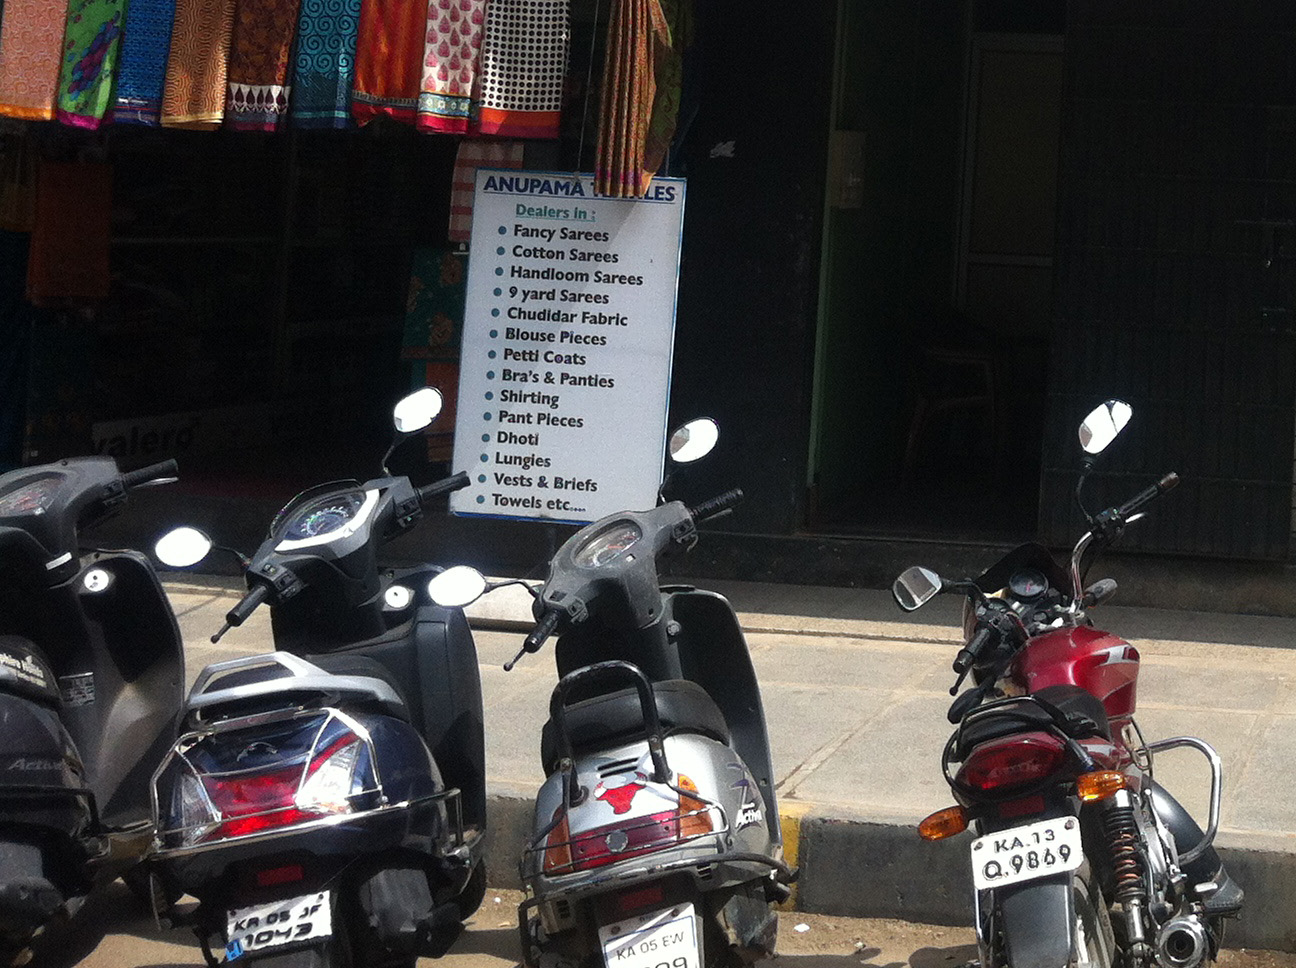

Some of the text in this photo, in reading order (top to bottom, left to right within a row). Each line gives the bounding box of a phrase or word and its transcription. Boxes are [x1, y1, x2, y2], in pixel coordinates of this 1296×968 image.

[483, 176, 586, 196] ANUPAMA
[515, 204, 587, 219] Dealers in
[513, 225, 609, 243] Fancy Sarees
[512, 245, 619, 263] Cotton Sarees
[510, 266, 644, 286] Handloom Sarees
[508, 286, 610, 304] 9 yard Sarees
[507, 307, 629, 327] Chudidar Fabric
[505, 328, 607, 346] Blouse Pieces
[503, 348, 587, 366] Petti Coats
[501, 369, 615, 388] Bra's & Panties
[500, 389, 560, 409] Shirting
[498, 410, 584, 428] Pant Pieces
[496, 431, 539, 446] Dhoti
[495, 452, 552, 470] Lungies
[493, 473, 599, 492] Vests & Briefs
[491, 493, 542, 509] Towels
[616, 946, 636, 961] KA
[640, 939, 658, 954] 05
